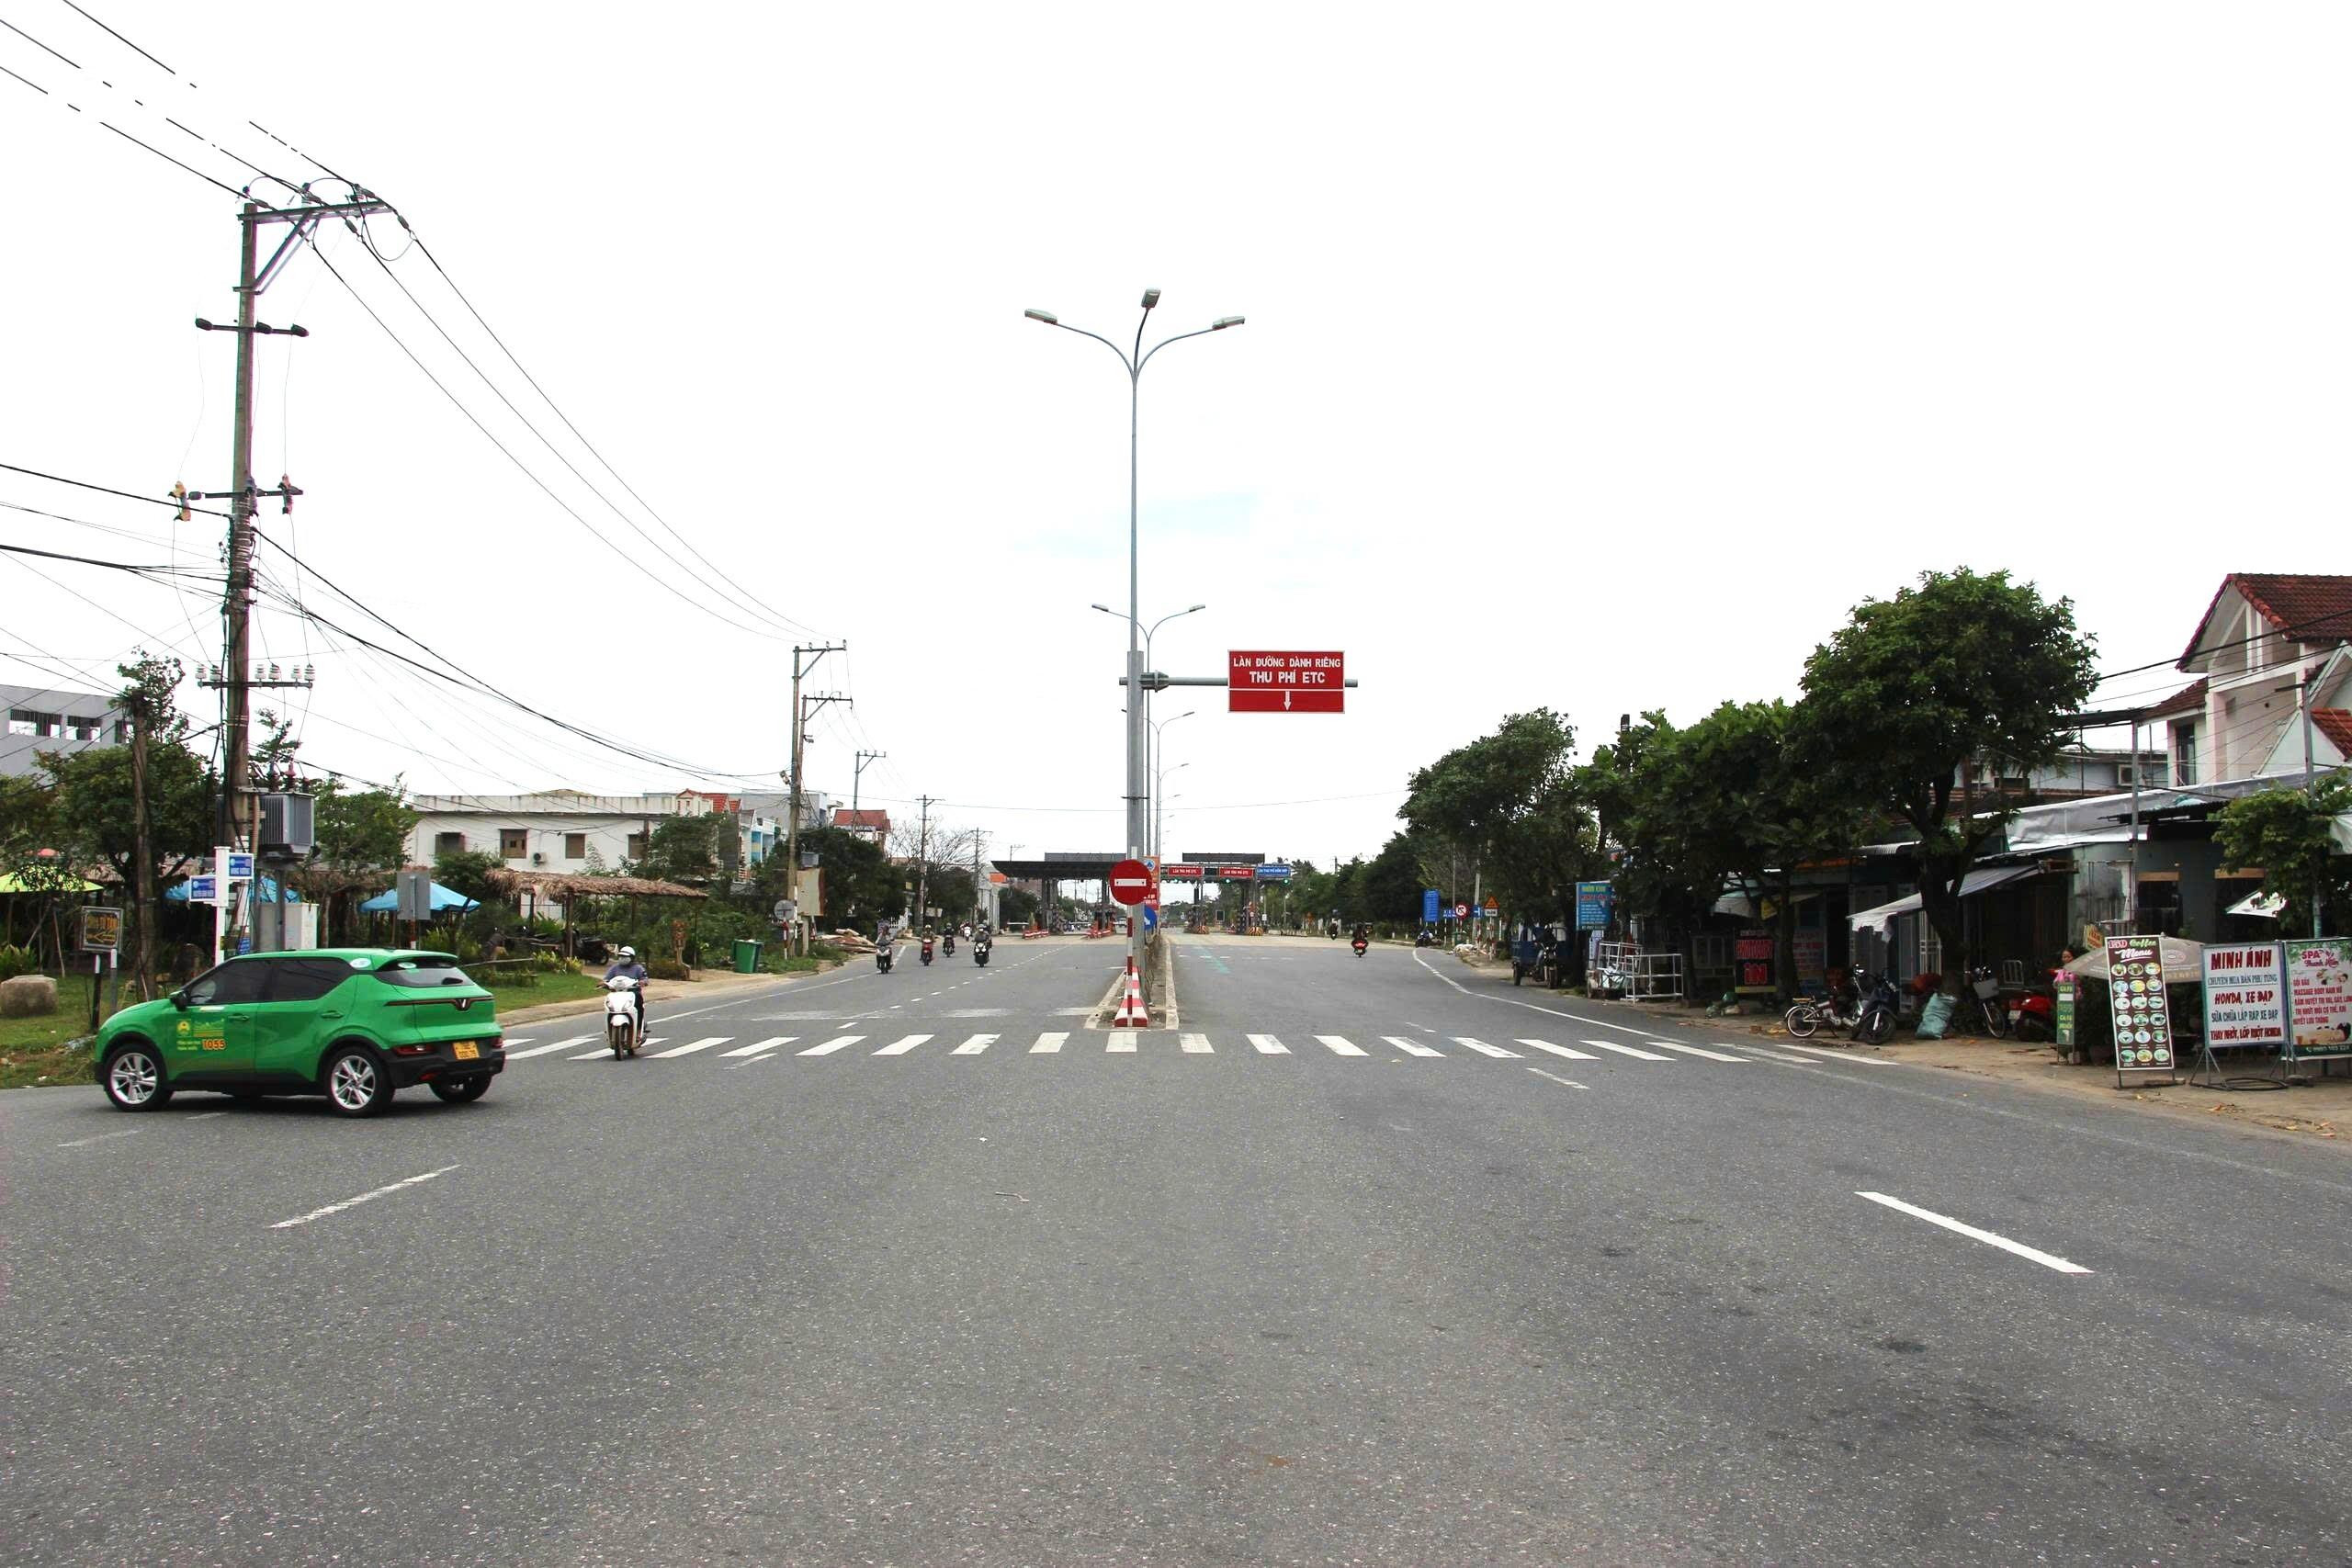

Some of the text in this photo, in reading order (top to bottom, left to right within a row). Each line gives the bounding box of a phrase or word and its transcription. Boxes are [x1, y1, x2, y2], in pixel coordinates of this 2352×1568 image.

[1233, 655, 1341, 668] LÀN ĐƯỜNG DÀNH RIÊNG
[1250, 670, 1325, 683] THU PHÍ ETC
[2115, 948, 2153, 958] Menu
[2211, 946, 2272, 970] MINH ÁNH
[2301, 950, 2320, 959] SPA
[2215, 990, 2273, 1005] HONDA, XE ĐẠP
[2260, 1009, 2267, 1020] XE
[2211, 1030, 2223, 1040] THAY
[2264, 1027, 2281, 1037] HONDA
